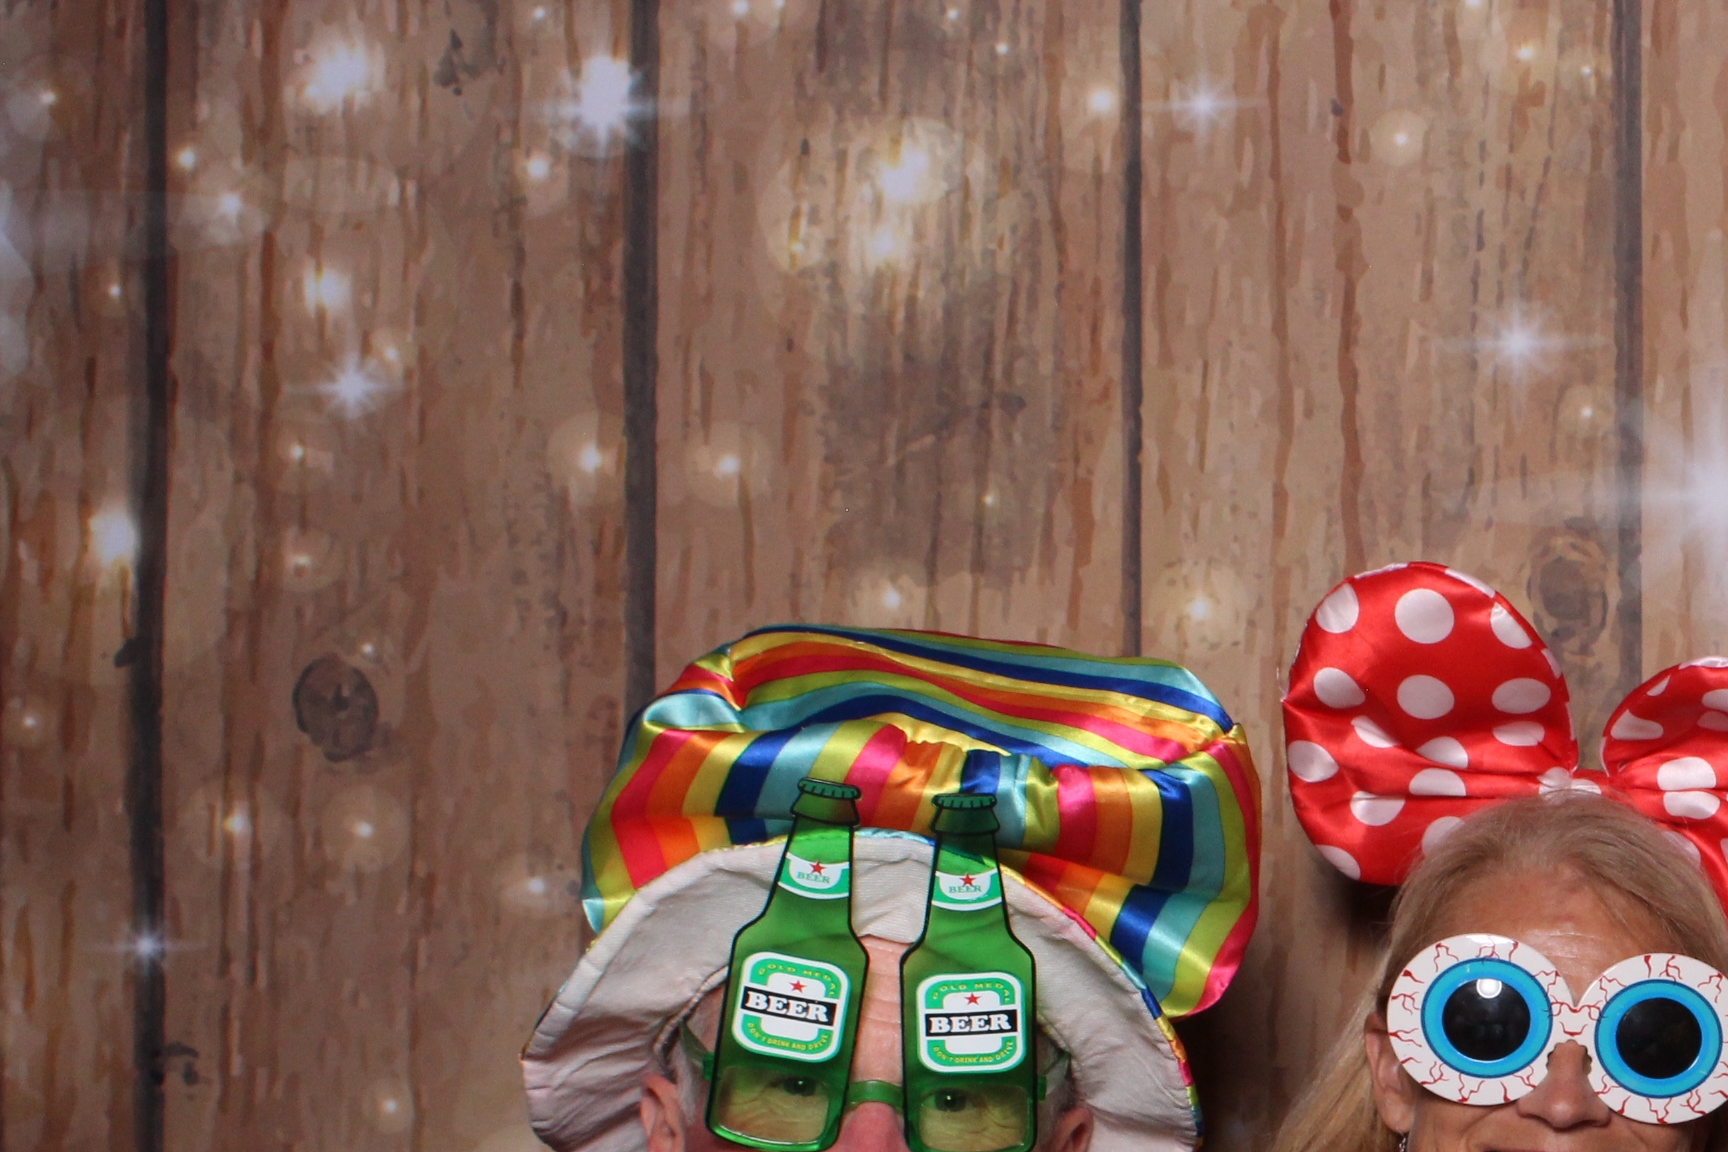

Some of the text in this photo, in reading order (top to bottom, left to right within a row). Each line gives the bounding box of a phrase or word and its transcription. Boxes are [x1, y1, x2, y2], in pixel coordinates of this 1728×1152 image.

[797, 871, 830, 884] BEER
[948, 884, 982, 894] BEER
[758, 963, 836, 997] GOLD MEDAL
[933, 983, 1011, 1004] GOLD MEDAL
[745, 991, 829, 1023] BEER
[928, 1013, 1012, 1034] BEER
[767, 1038, 790, 1048] DRINK
[791, 1042, 807, 1051] AND
[808, 1034, 829, 1051] DRIVE
[979, 1055, 994, 1063] AND
[995, 1041, 1014, 1060] DRIVE
